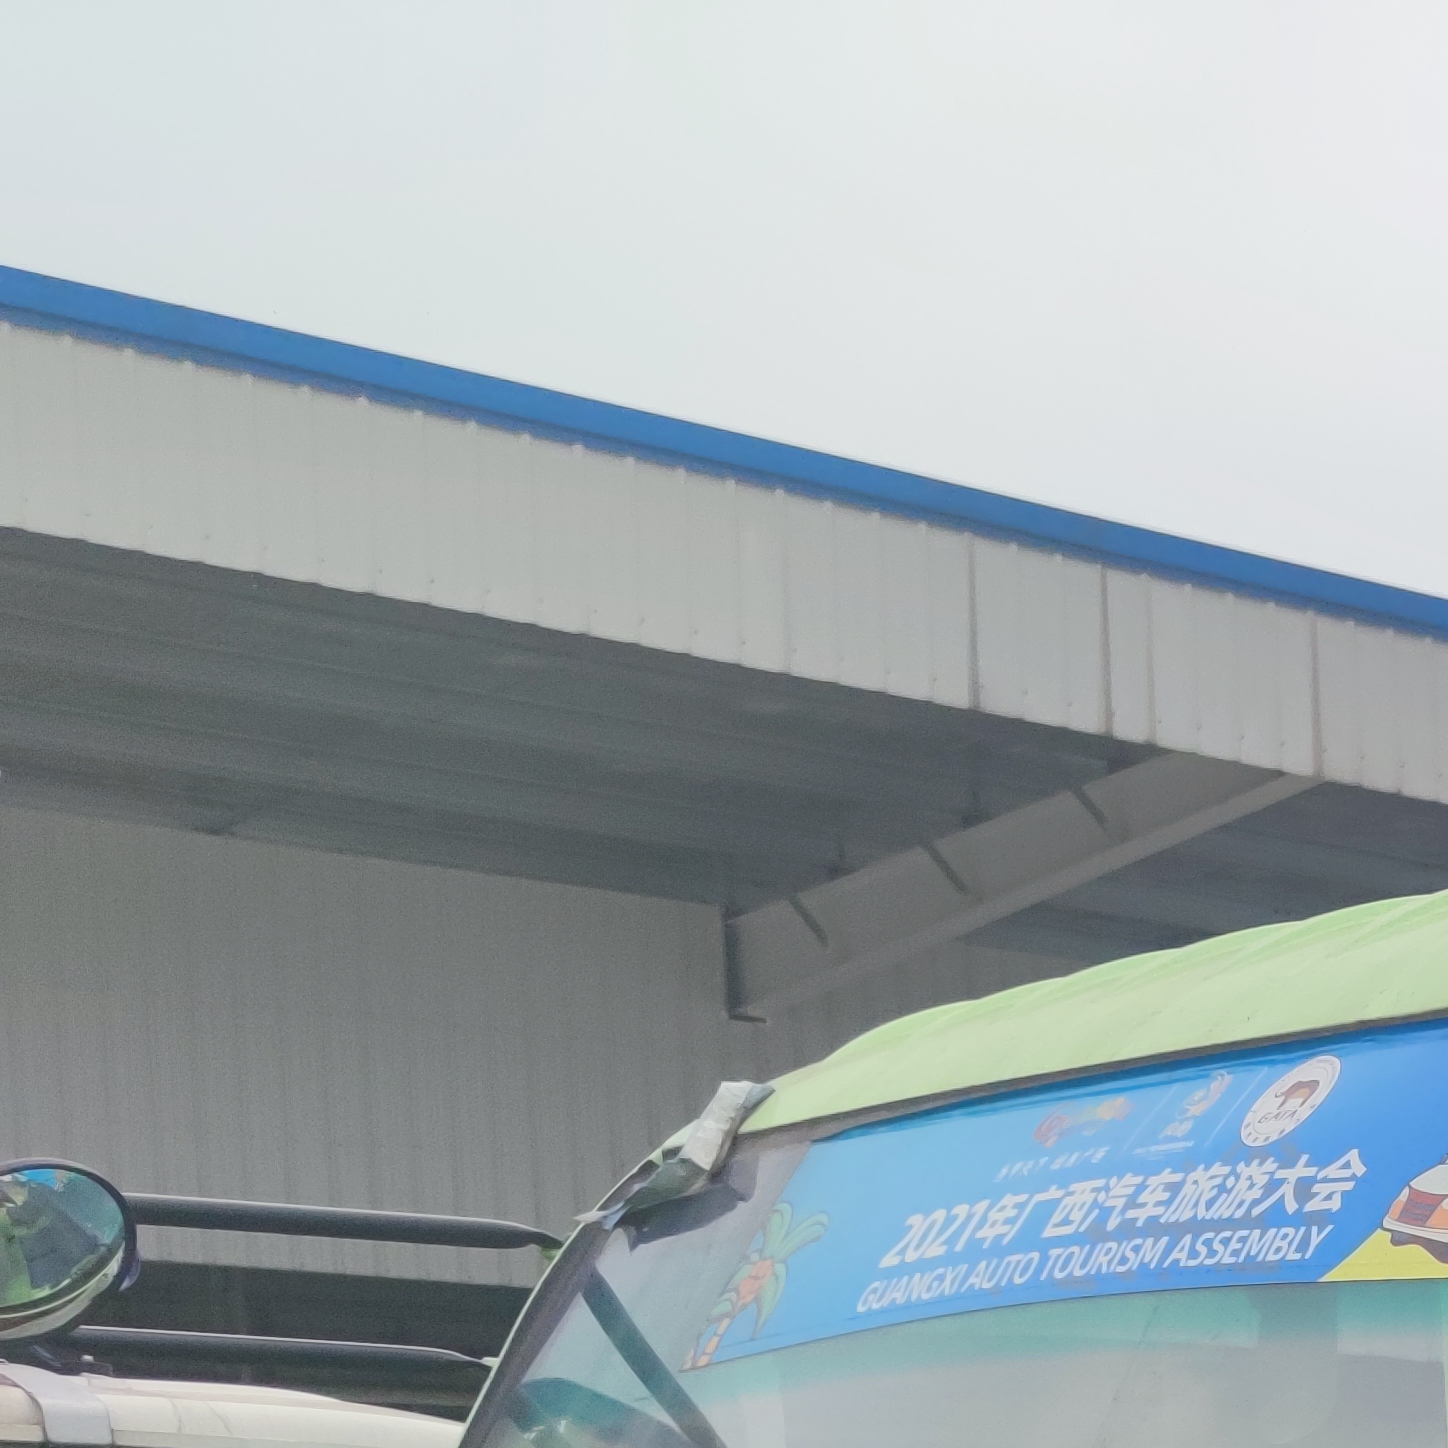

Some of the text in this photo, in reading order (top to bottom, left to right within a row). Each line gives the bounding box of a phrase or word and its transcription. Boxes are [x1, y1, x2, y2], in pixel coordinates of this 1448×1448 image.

[878, 1149, 1367, 1268] 2021年广西汽车旅游大会
[856, 1225, 1335, 1313] GUANGXI AUTO TOURISM ASSEMBLY
